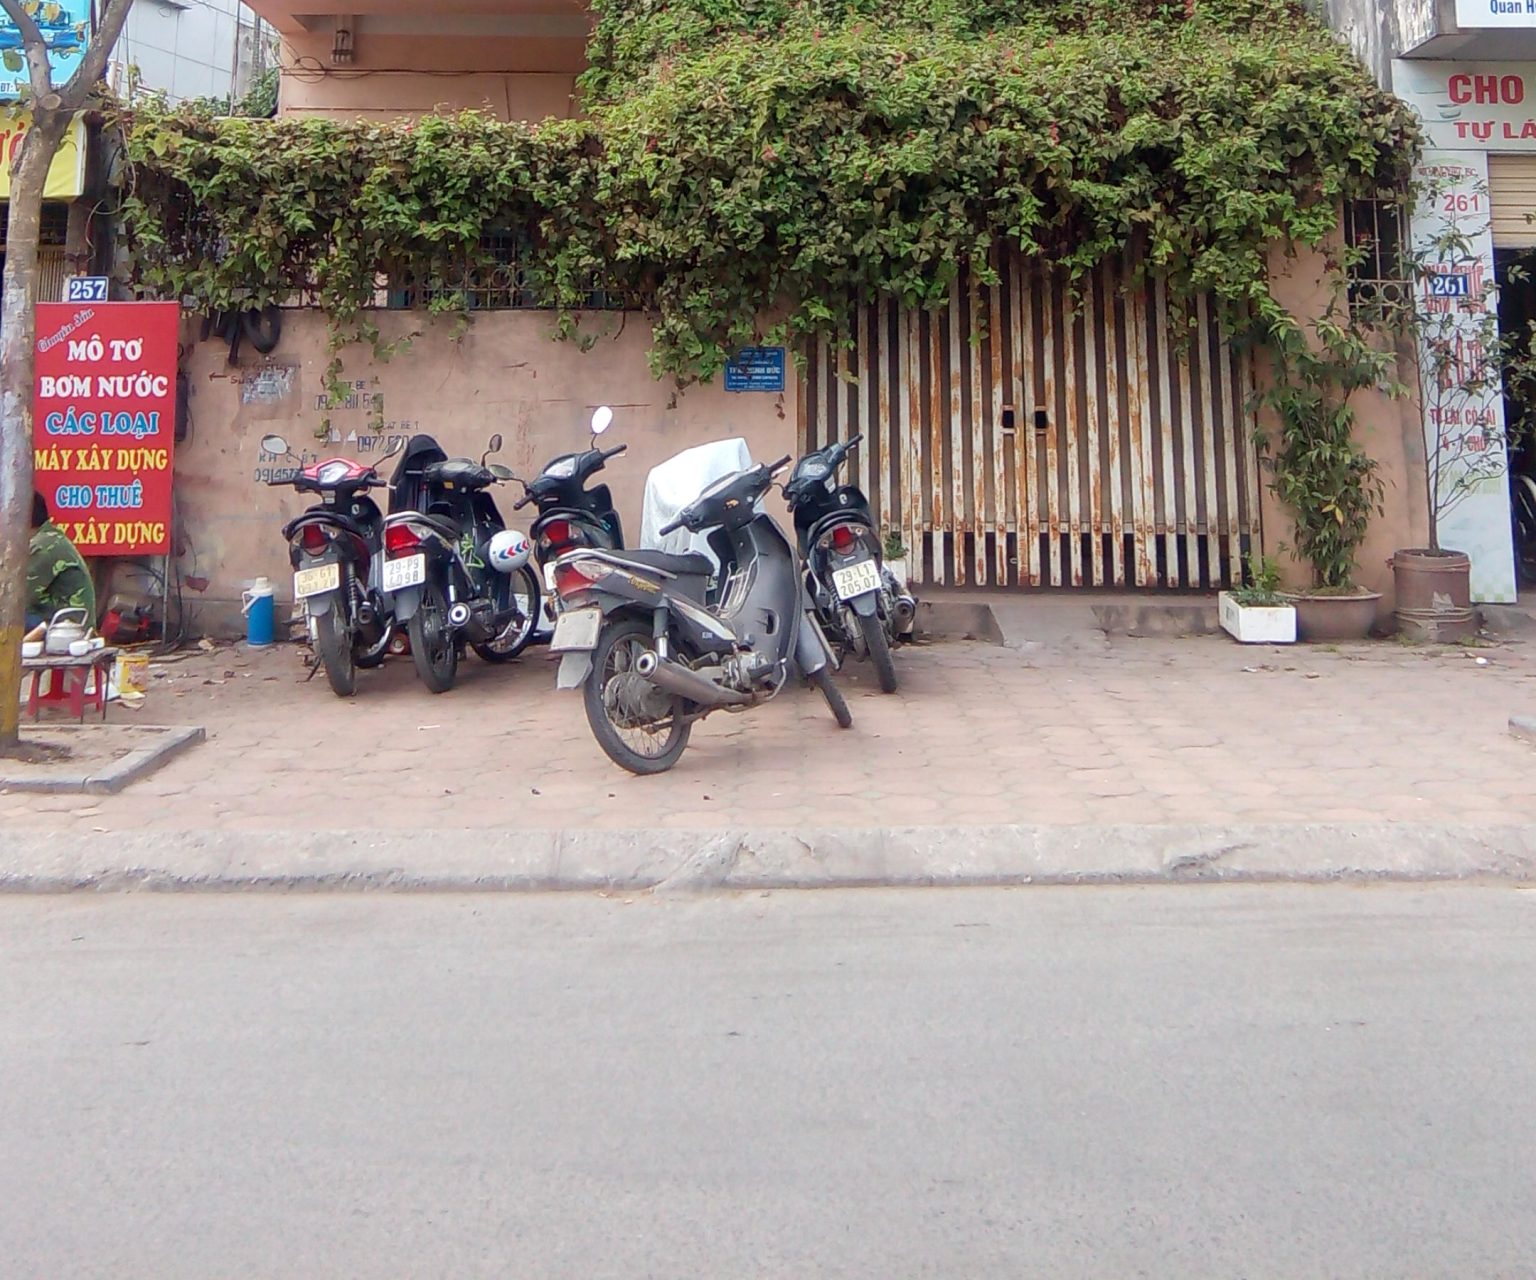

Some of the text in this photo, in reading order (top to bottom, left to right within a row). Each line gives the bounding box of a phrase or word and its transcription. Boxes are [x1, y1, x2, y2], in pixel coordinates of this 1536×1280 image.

[1490, 0, 1522, 14] Quan
[1448, 74, 1524, 104] CHO
[1453, 121, 1495, 142] TỰ
[1443, 194, 1479, 212] 261
[70, 280, 106, 300] 257
[1433, 276, 1467, 295] 261
[67, 333, 144, 361] MÔ TƠ
[40, 370, 168, 398] BƠM NƯỚC
[46, 406, 160, 440] CÁC LOẠI
[34, 442, 168, 477] MÁY XÂY DỰNG
[56, 482, 144, 509] CHO THUÊ
[73, 516, 110, 545] XÂY
[113, 521, 166, 549] DỰNG
